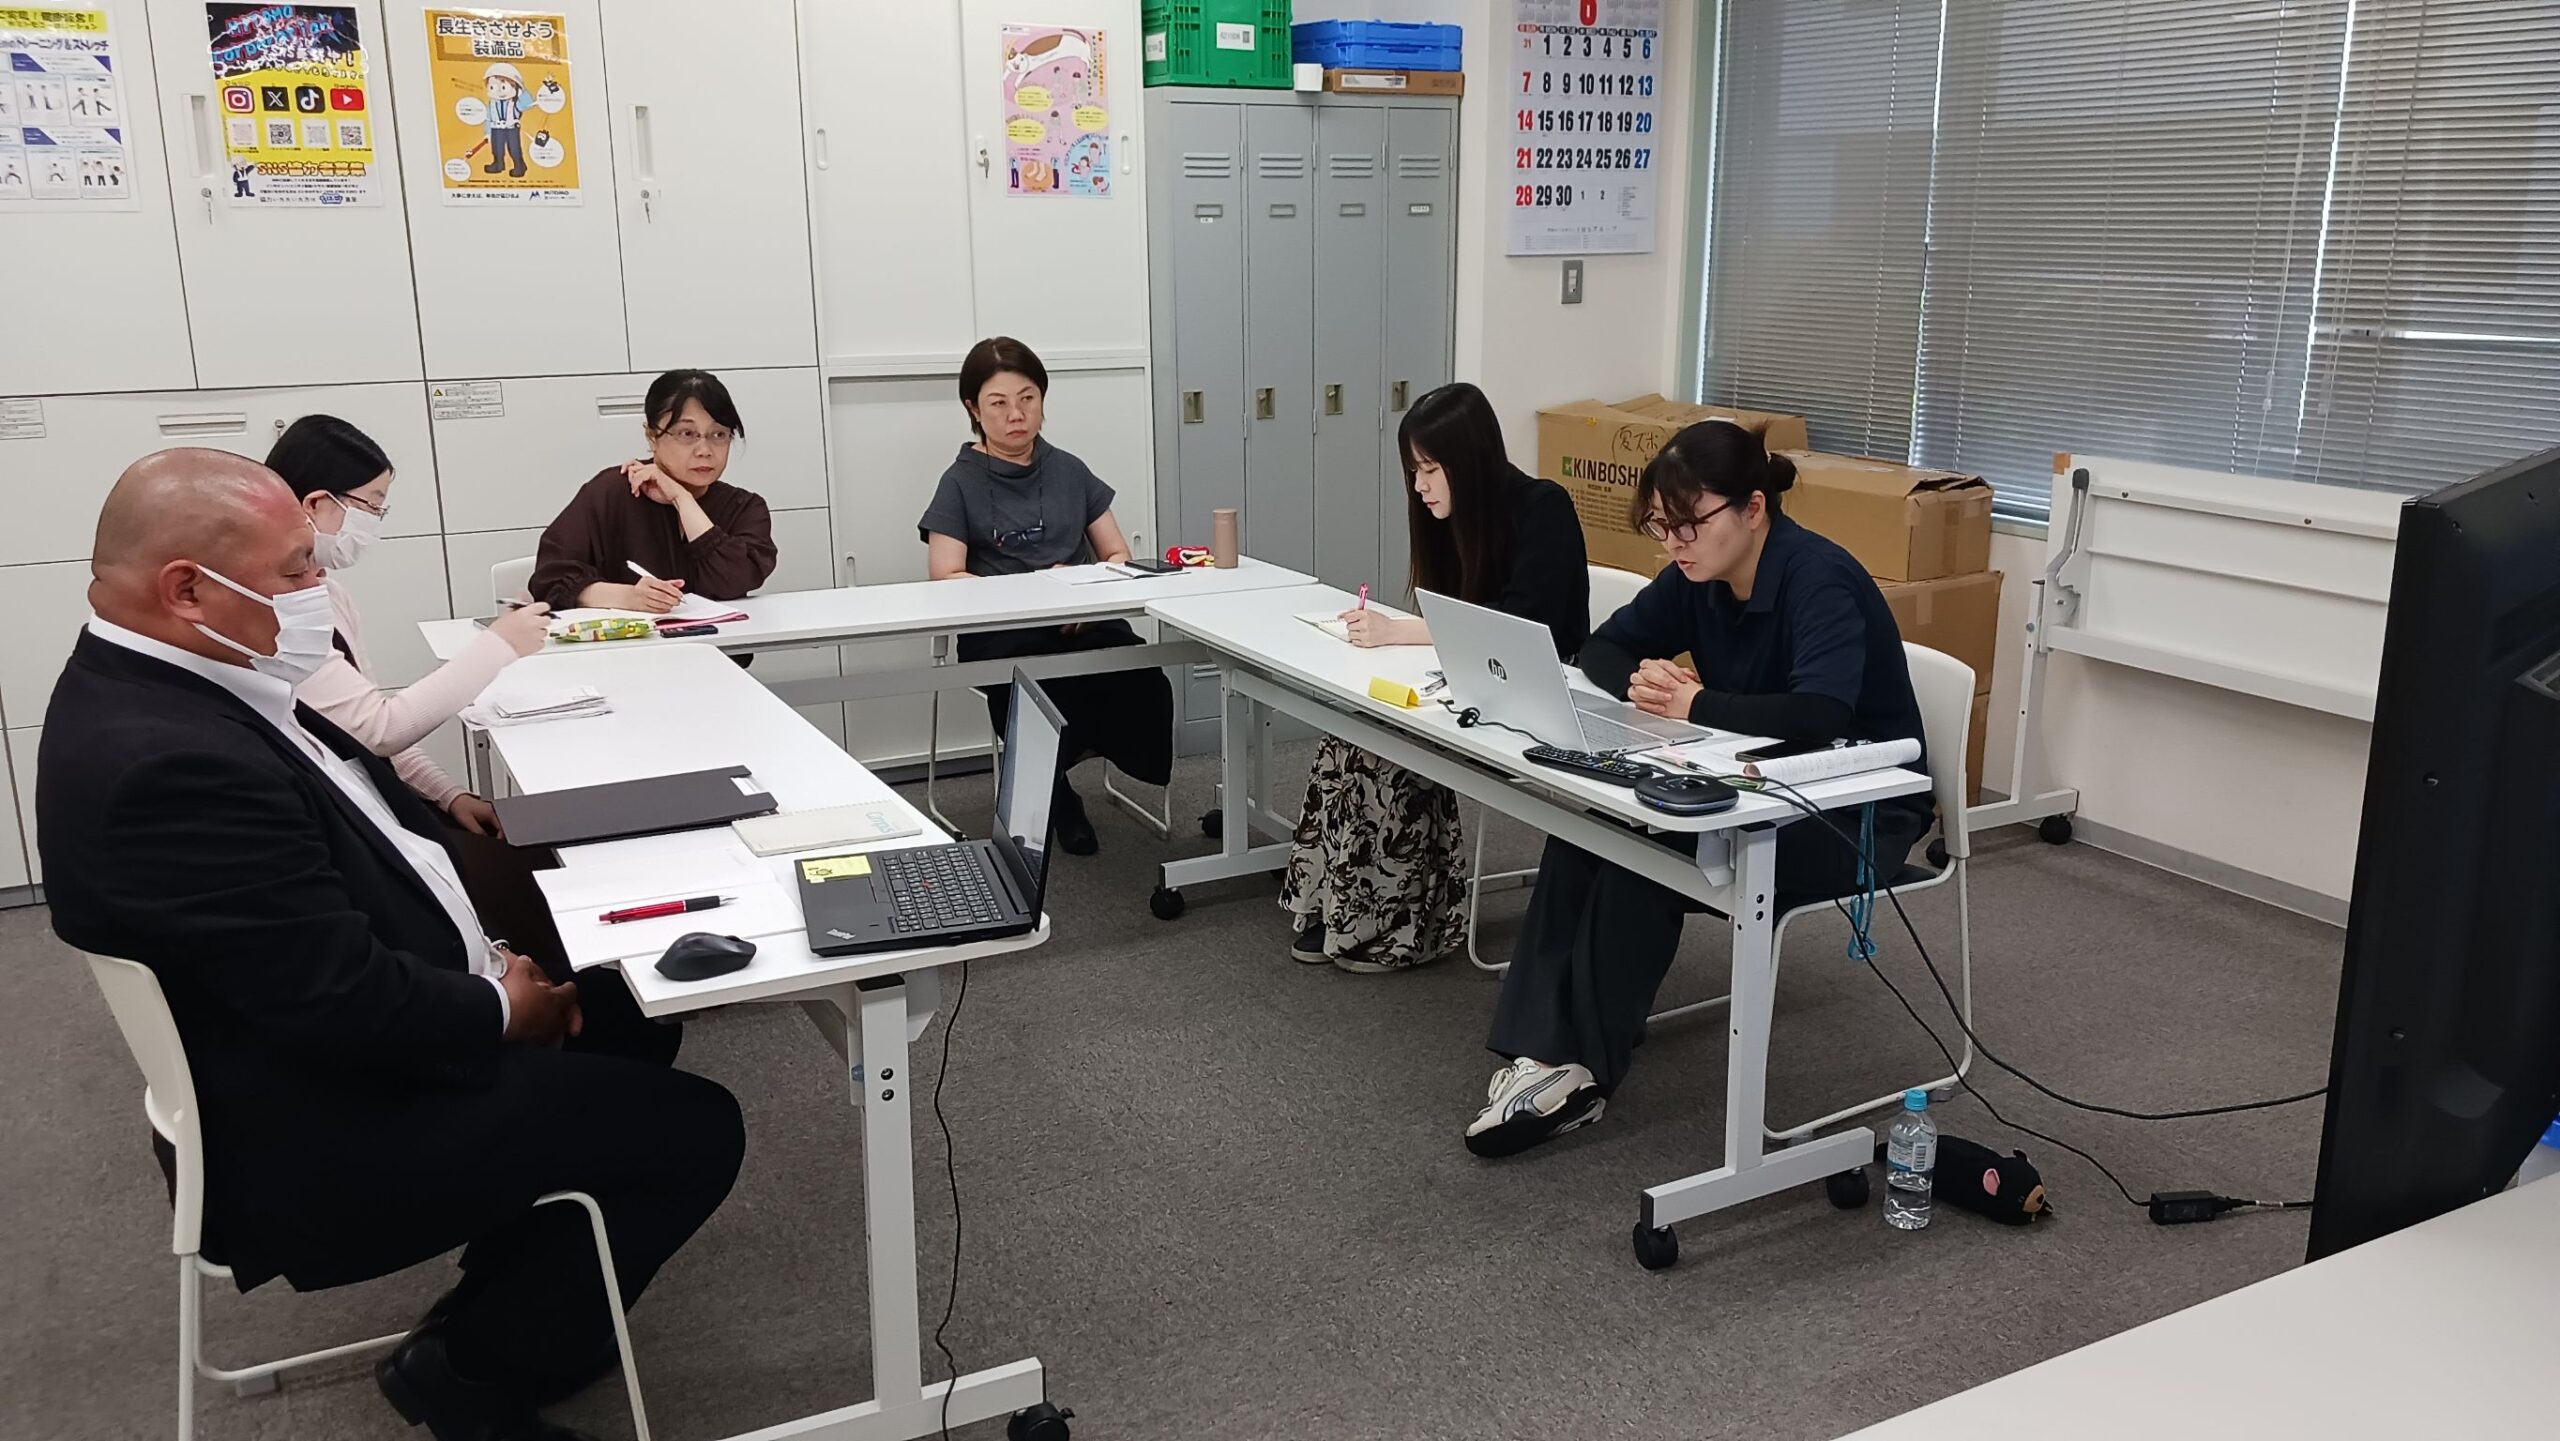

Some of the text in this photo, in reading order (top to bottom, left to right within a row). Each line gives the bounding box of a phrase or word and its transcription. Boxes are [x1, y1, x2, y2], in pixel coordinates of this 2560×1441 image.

[438, 18, 553, 38] 長生きさせよう
[473, 40, 523, 56] 装備品
[1544, 35, 1550, 55] 1
[1564, 35, 1572, 56] 2
[1583, 36, 1591, 57] 3
[1603, 37, 1611, 57] 4
[1623, 38, 1631, 58] 5
[1643, 38, 1650, 59] 6
[1523, 72, 1653, 96] 7 8 9 10 11 12 13
[1518, 110, 1651, 133] 14 15 16 17 18 19 20
[1517, 148, 1650, 169] 21 22 23 24 25 26 27
[1516, 185, 1532, 206] 28
[1536, 185, 1552, 206] 29
[1556, 185, 1572, 206] 30
[1573, 457, 1644, 487] KINBOSH
